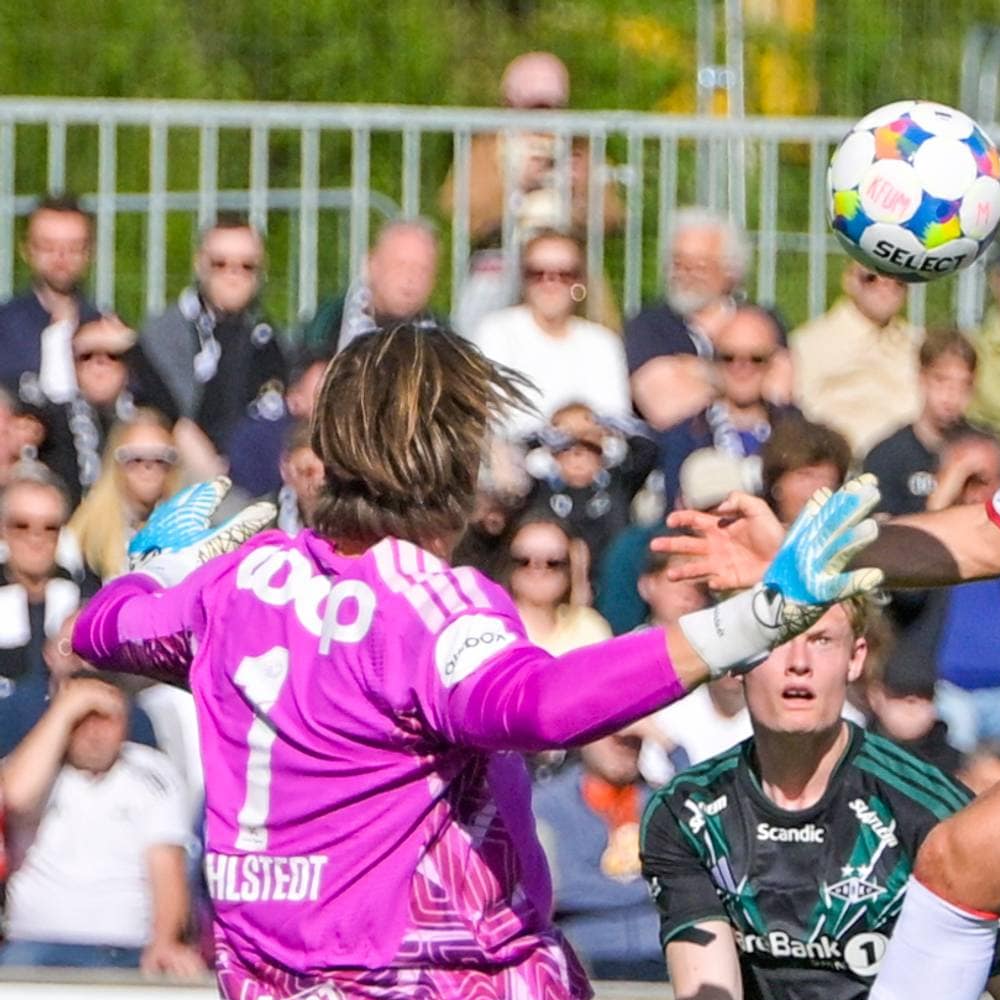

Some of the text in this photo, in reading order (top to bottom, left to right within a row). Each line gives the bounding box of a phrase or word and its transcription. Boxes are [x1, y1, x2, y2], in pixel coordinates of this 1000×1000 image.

[873, 239, 967, 272] SELECT
[233, 645, 290, 851] 1
[756, 823, 825, 843] Scandic
